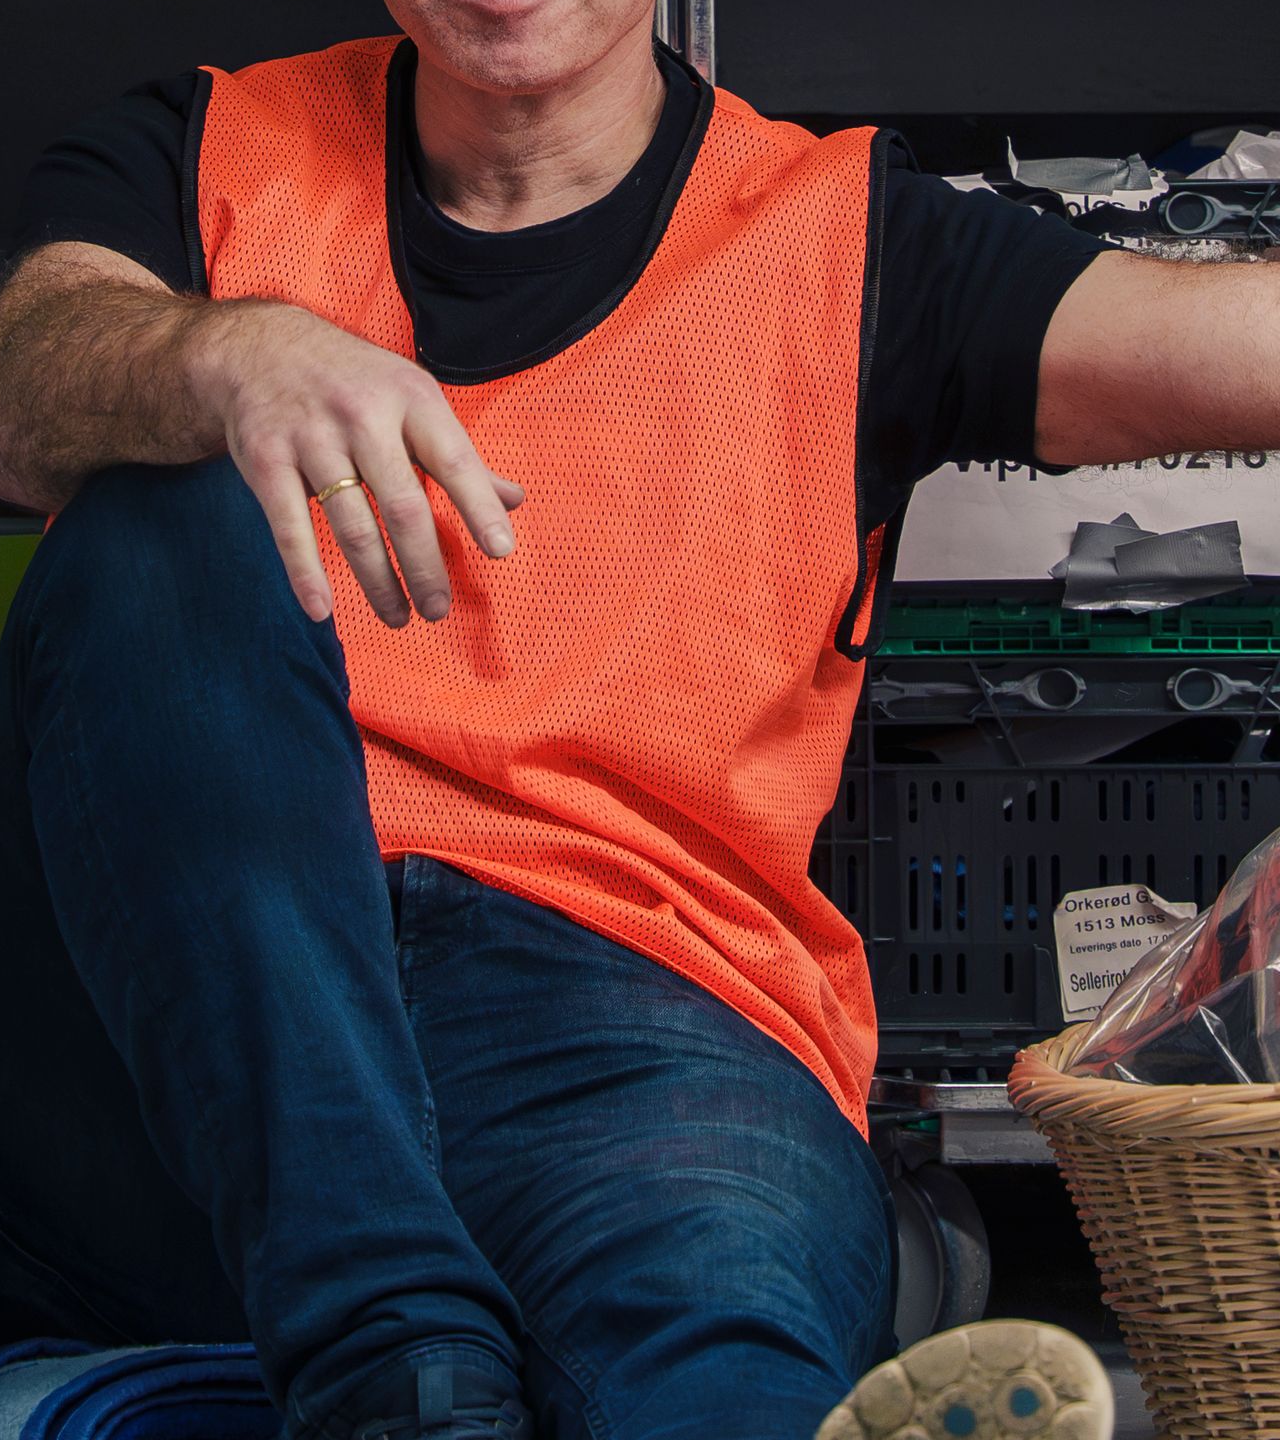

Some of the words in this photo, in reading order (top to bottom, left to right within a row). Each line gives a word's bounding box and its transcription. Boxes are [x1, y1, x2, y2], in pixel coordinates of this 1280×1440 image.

[1064, 892, 1131, 913] Orkerød
[1074, 917, 1115, 933] 1513
[1120, 913, 1166, 928] Moss
[1069, 941, 1117, 955] Leverings
[1120, 938, 1142, 949] dato
